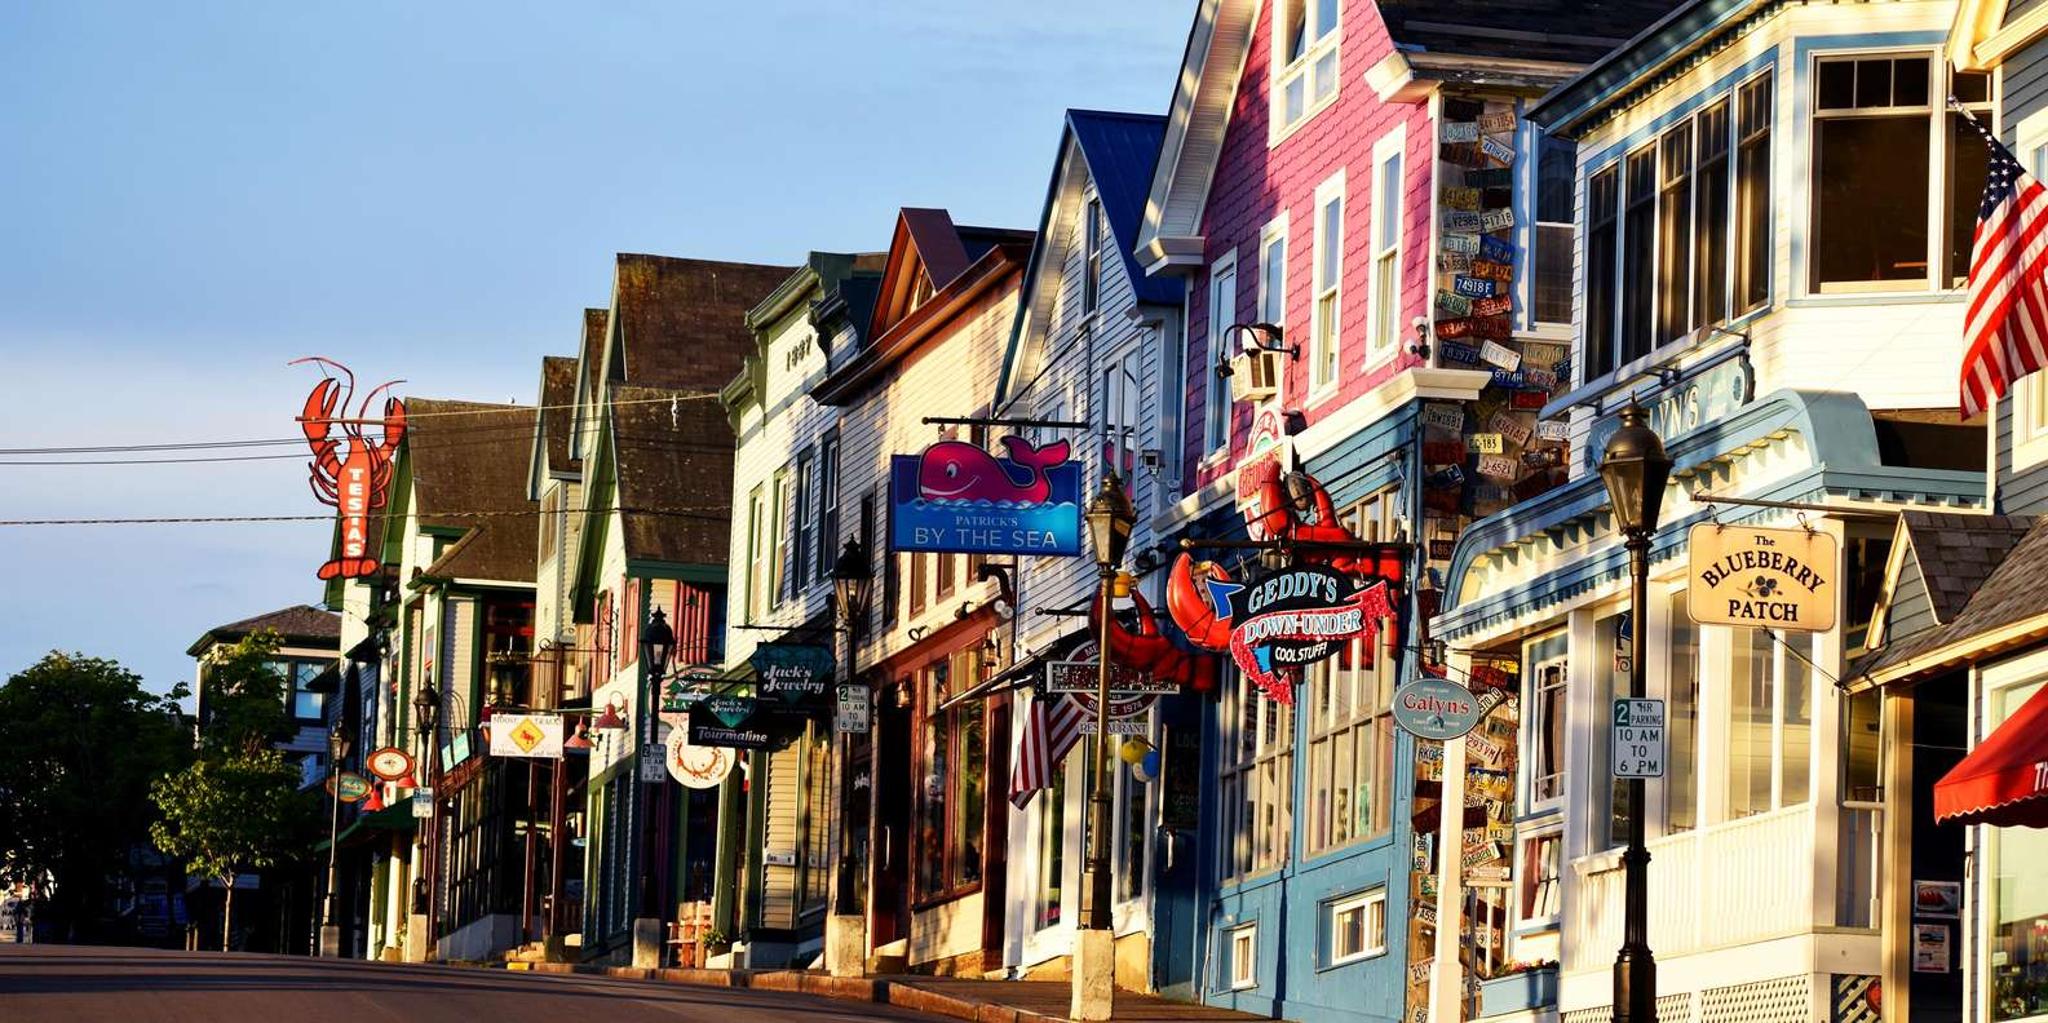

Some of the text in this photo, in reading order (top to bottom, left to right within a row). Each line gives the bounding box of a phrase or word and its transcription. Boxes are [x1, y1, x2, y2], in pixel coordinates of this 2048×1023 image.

[786, 333, 812, 372] 1887
[347, 468, 366, 557] TESTA'S
[955, 515, 1018, 527] PATRICK'S
[914, 527, 1058, 549] BY THE SEA
[1754, 535, 1775, 547] The
[1701, 550, 1826, 593] BLUEBERRY
[1248, 572, 1337, 613] GEDDY'S
[1728, 599, 1799, 621] PATCH
[1274, 641, 1328, 661] COOL STUFF!
[763, 664, 813, 679] Jack's
[762, 677, 825, 695] Jewelry
[841, 687, 848, 700] 2
[842, 703, 866, 711] 10 AM
[1403, 693, 1470, 719] Galyn's
[1616, 702, 1653, 723] 2 HR
[1631, 714, 1661, 725] PARKING
[697, 729, 768, 744] Tourmaline
[1619, 729, 1658, 742] 10 AM
[1632, 745, 1647, 757] TO
[1620, 760, 1658, 773] 6 PM
